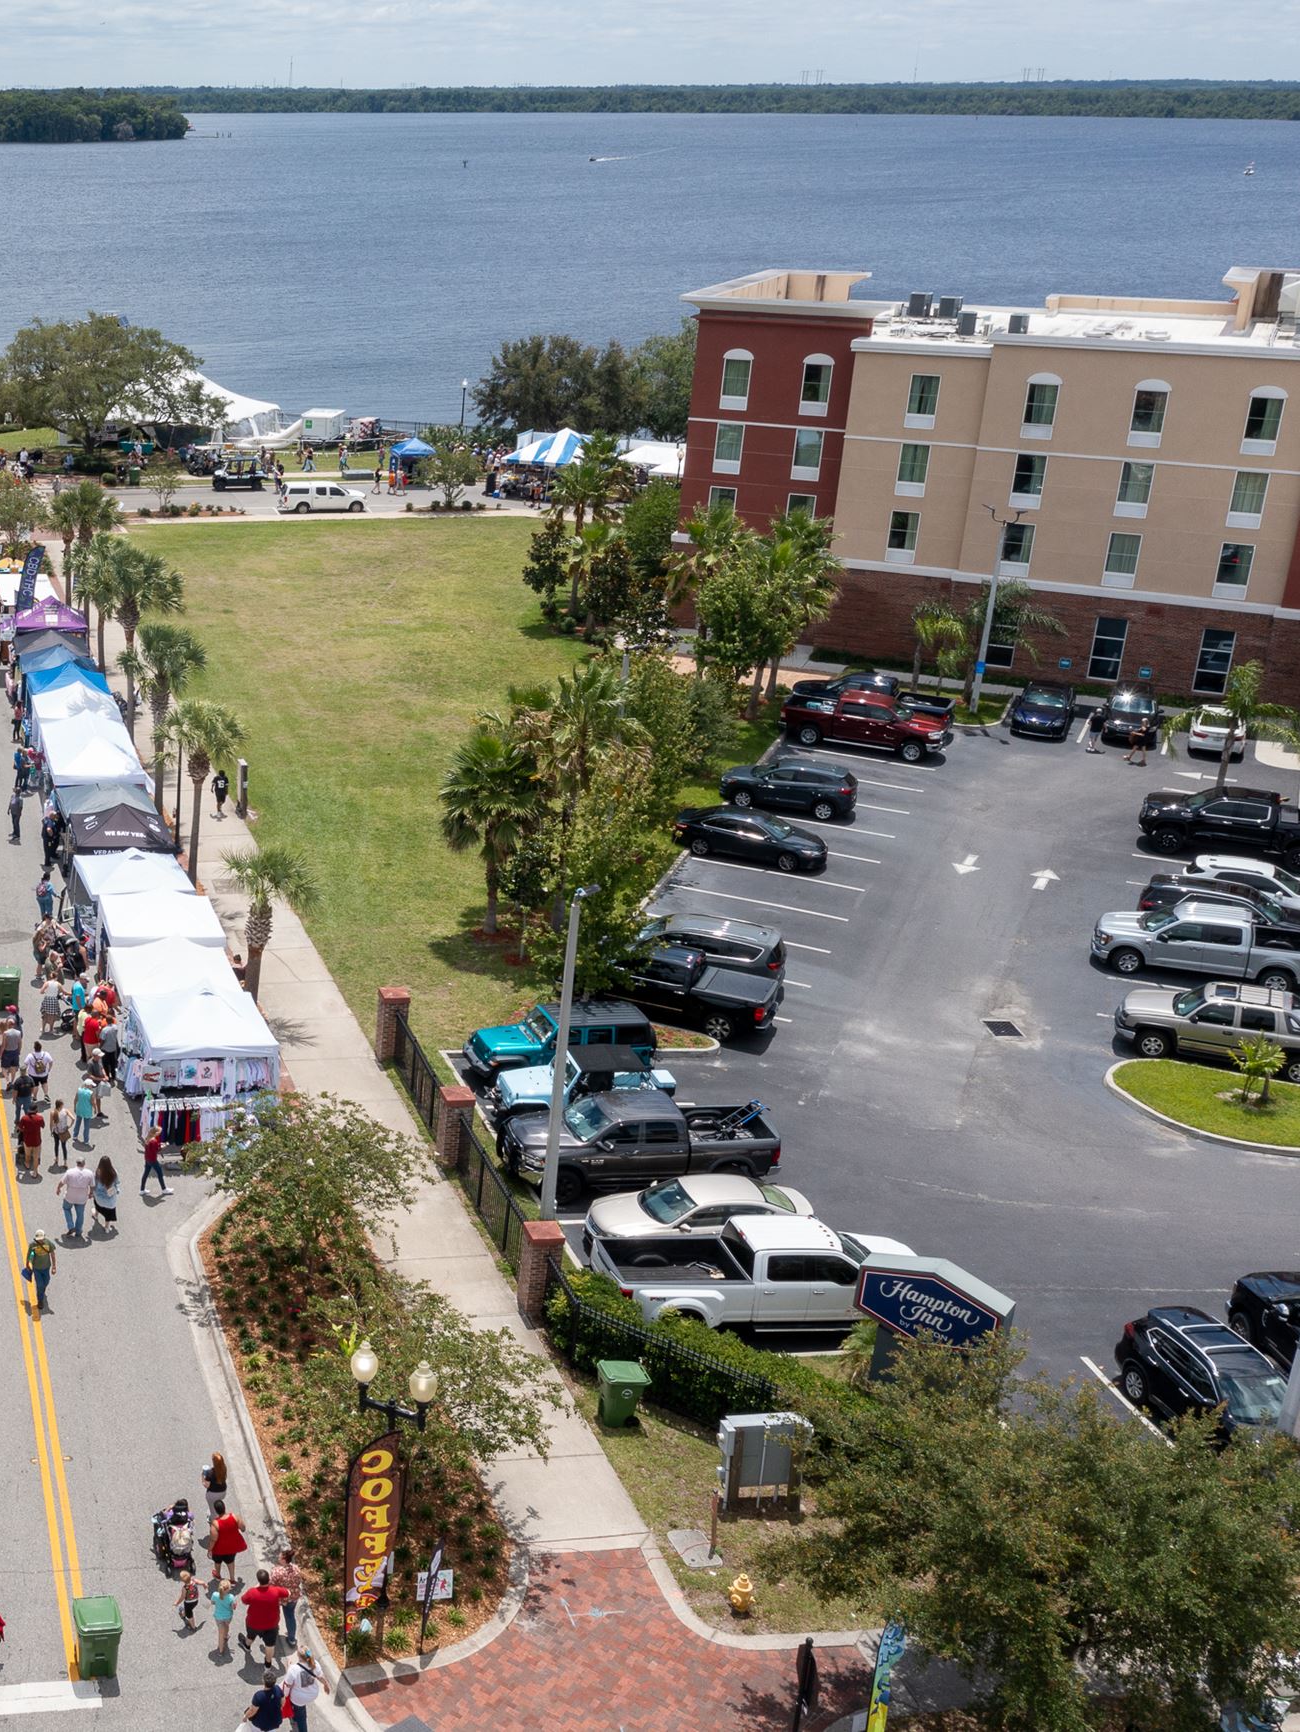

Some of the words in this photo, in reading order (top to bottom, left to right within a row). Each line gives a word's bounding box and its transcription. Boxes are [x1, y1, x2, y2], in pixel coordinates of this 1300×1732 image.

[23, 556, 40, 597] CBD-THC
[880, 1280, 980, 1325] Hampton
[900, 1305, 953, 1332] Inn
[899, 1318, 910, 1328] by
